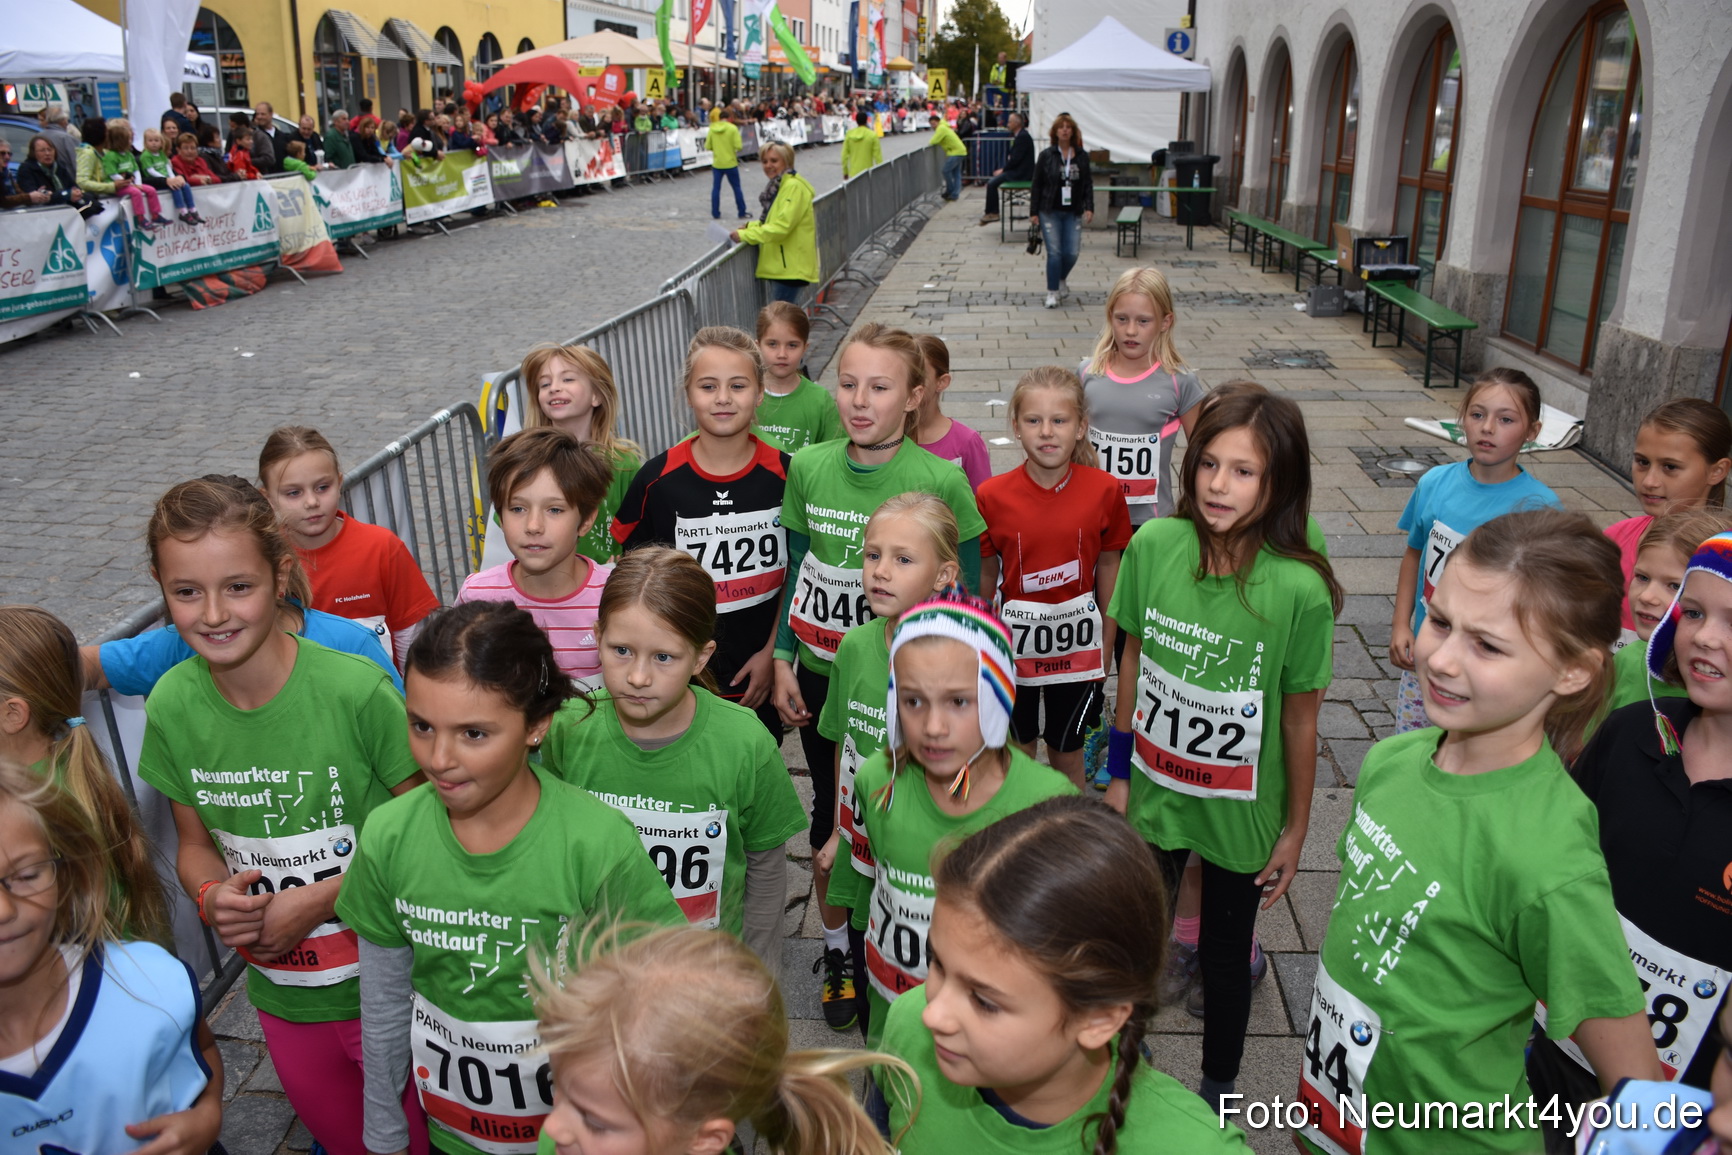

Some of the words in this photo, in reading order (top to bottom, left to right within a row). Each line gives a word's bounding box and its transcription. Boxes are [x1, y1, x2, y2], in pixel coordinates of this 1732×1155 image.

[650, 78, 661, 92] A
[932, 78, 943, 93] A
[1105, 434, 1146, 444] Neumarkt
[677, 527, 713, 538] PARTL
[715, 521, 769, 535] Neumarkt
[807, 518, 860, 541] Stadtlauf
[1430, 528, 1453, 549] PARTL
[686, 533, 779, 575] 7429
[1038, 571, 1064, 586] DEHN
[343, 593, 371, 602] Holzheim
[716, 580, 756, 598] Mona
[800, 577, 878, 627] 7046
[1004, 608, 1037, 621] PARTL
[1039, 606, 1086, 622] Neumarkt
[1011, 617, 1094, 655] 7090
[1144, 606, 1223, 646] Neumarkter
[816, 630, 841, 650] Len
[1034, 658, 1072, 674] Paula
[1142, 667, 1169, 697] PARTL
[1171, 689, 1235, 716] Neumarkt
[1144, 689, 1247, 762] 7122
[190, 766, 290, 785] Neumarkter
[1156, 752, 1213, 785] Leonie
[196, 788, 273, 808] Stadtlauf
[635, 825, 700, 839] eumarkt
[251, 848, 327, 868] Neumarkt
[395, 897, 512, 931] Neumarkter
[1373, 880, 1441, 985] BAMBINI
[415, 1008, 458, 1046] PARTL
[469, 1115, 536, 1140] Alicia
